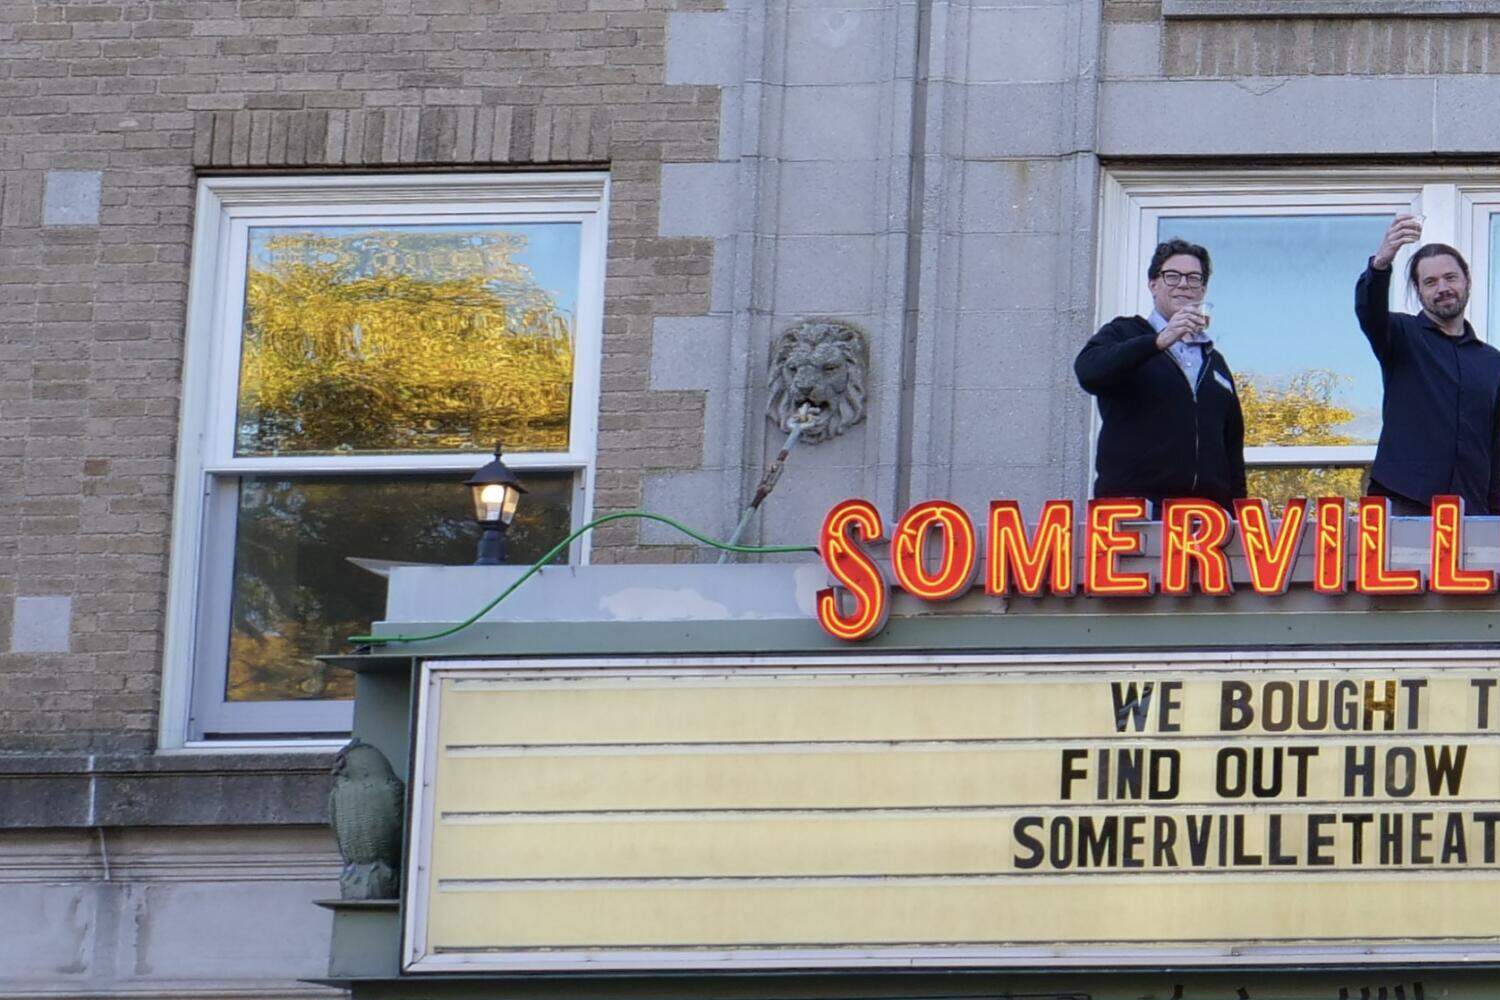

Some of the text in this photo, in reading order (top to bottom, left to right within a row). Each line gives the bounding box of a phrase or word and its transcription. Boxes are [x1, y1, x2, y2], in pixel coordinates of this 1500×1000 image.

[1111, 680, 1183, 732] WE
[1219, 678, 1428, 732] BOUGHT
[1060, 748, 1181, 800] FIND
[1215, 746, 1320, 798] OUT
[1344, 744, 1468, 797] HOW
